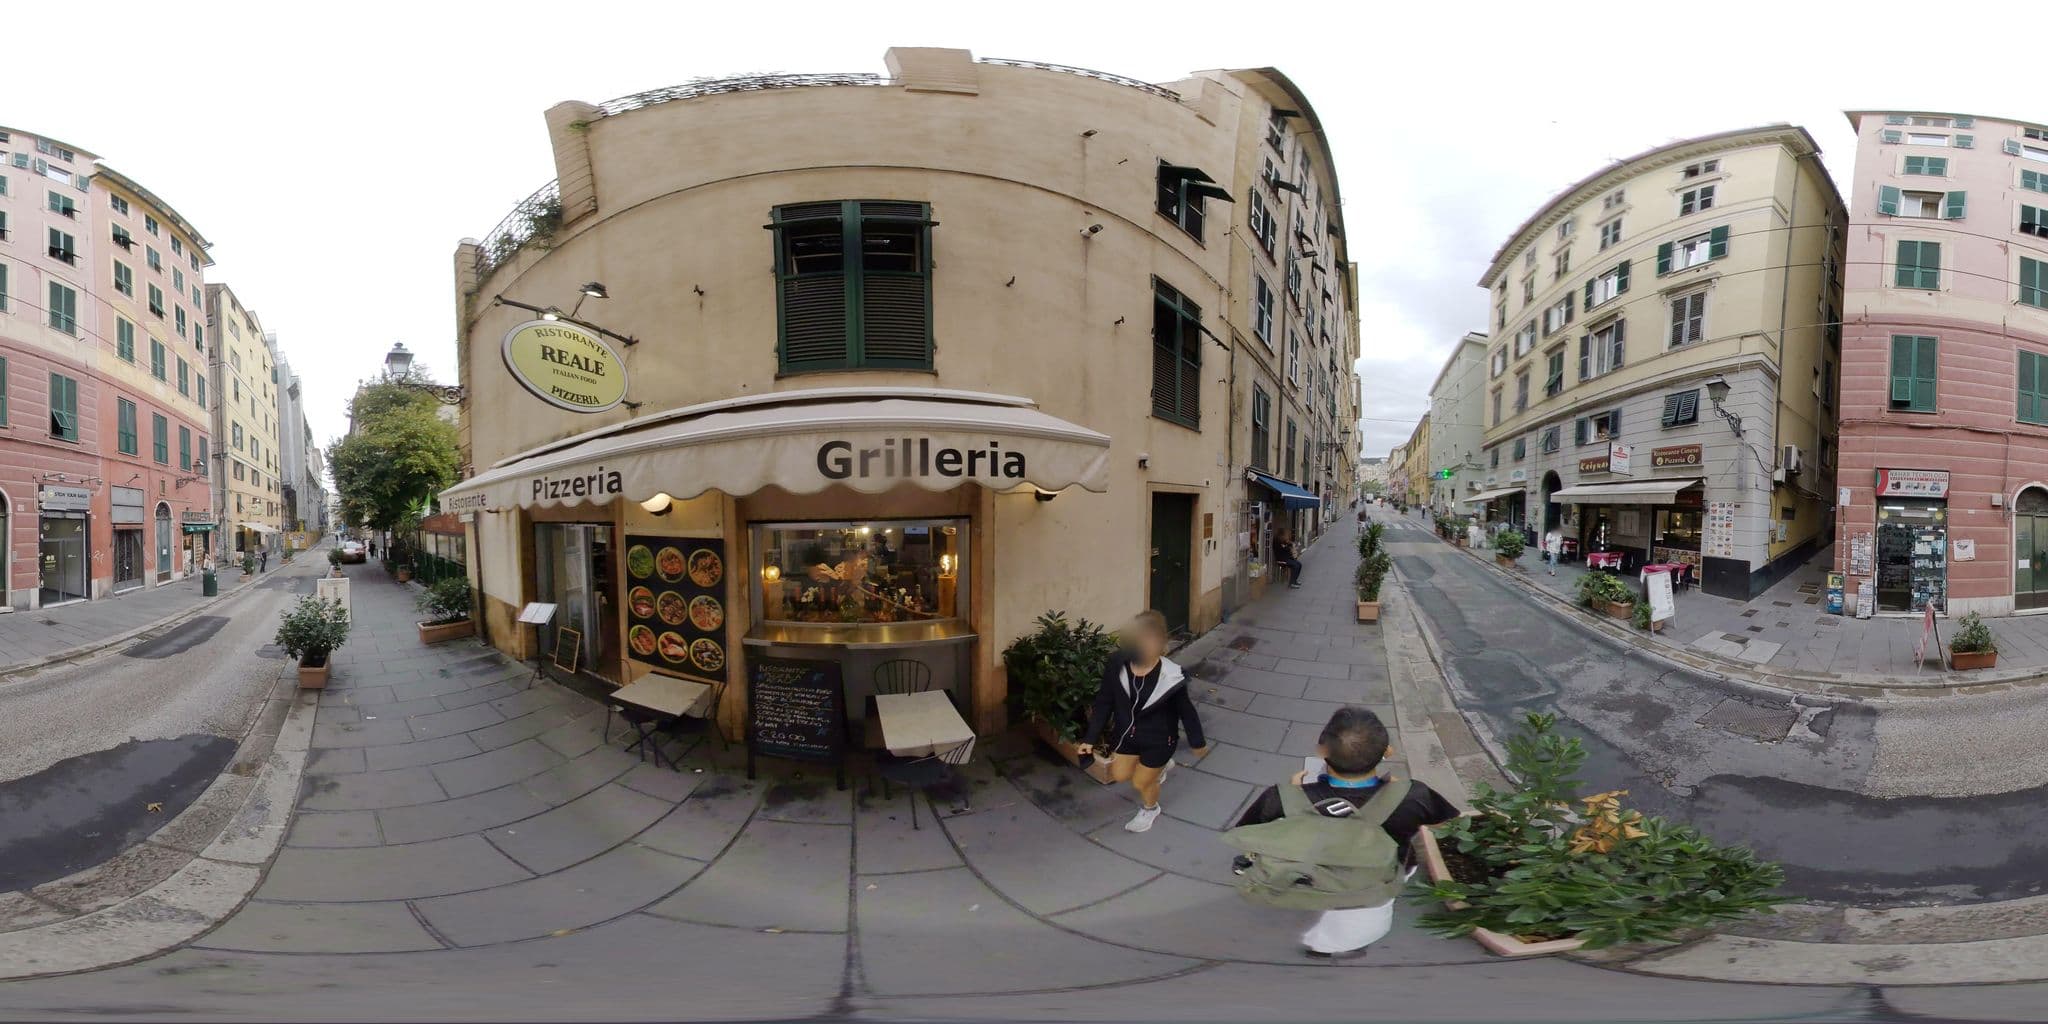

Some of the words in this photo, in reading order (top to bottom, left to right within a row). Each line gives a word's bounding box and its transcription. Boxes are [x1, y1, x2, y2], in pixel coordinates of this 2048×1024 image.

[535, 328, 608, 359] RISTORANTE
[541, 344, 606, 377] REALE
[552, 367, 580, 381] ITALIAN
[580, 374, 597, 385] FOOD
[551, 385, 600, 405] PIZZERIA
[816, 438, 1026, 480] Grilleria
[532, 466, 623, 501] Pizzeria
[448, 493, 487, 511] Ristorante
